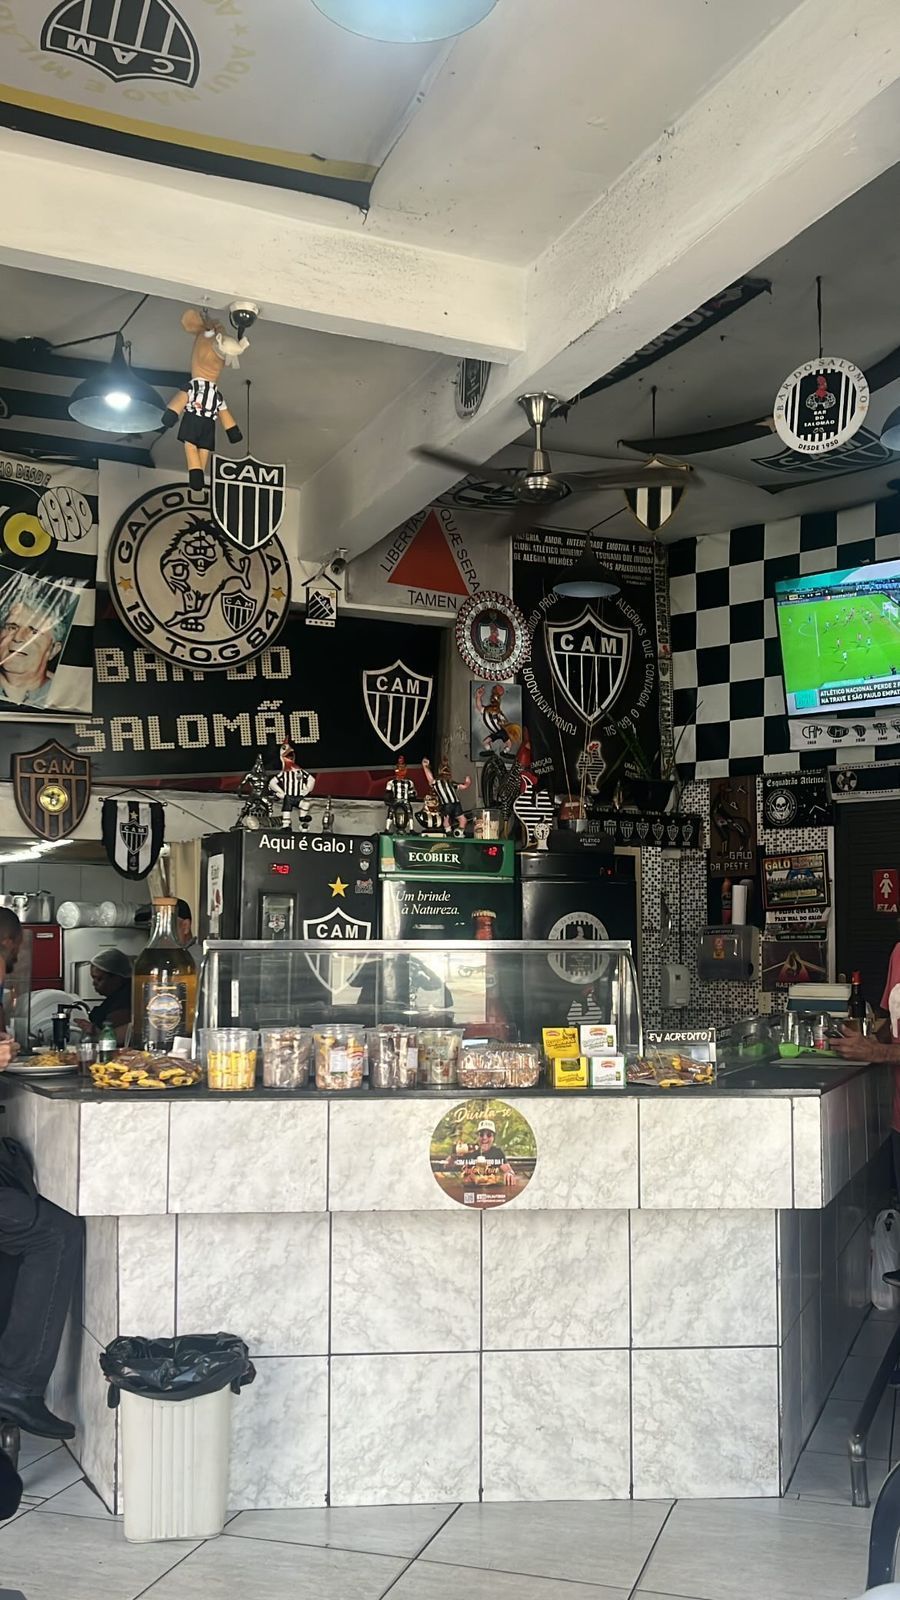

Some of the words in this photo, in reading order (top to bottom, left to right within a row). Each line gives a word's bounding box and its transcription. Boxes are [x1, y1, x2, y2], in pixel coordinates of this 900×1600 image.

[794, 363, 813, 379] DO
[798, 443, 820, 451] DESDE
[822, 440, 840, 450] 1950
[16, 464, 52, 486] DESDE
[219, 461, 281, 485] CAM
[117, 489, 283, 576] GALOUA
[379, 509, 428, 573] LIBERTAS
[407, 589, 458, 610] TAMEN
[225, 598, 254, 608] CAM
[615, 598, 647, 637] ALEGRIAS
[560, 633, 617, 655] CAM
[641, 639, 655, 659] QUE
[375, 676, 421, 696] CAM
[637, 663, 656, 708] CONTAGIA
[820, 687, 845, 697] ATLÉTICO
[845, 685, 873, 694] NACIONAL
[874, 683, 893, 691] PERDE
[630, 708, 640, 720] O
[74, 700, 321, 753] SALOMÃO
[603, 714, 633, 737] BRSIL
[32, 758, 76, 775] CAM
[259, 834, 296, 853] Aqui
[298, 836, 309, 851] é
[311, 837, 347, 854] Galo
[408, 851, 461, 864] ECOBIER
[729, 851, 753, 860] GALO
[765, 859, 791, 871] GALO
[396, 890, 415, 902] Um
[417, 890, 451, 902] brinde
[401, 903, 409, 915] à
[411, 903, 460, 915] Natureza.
[876, 903, 898, 913] ELA
[316, 923, 359, 939] CAM
[453, 1106, 513, 1123] Divirta-se
